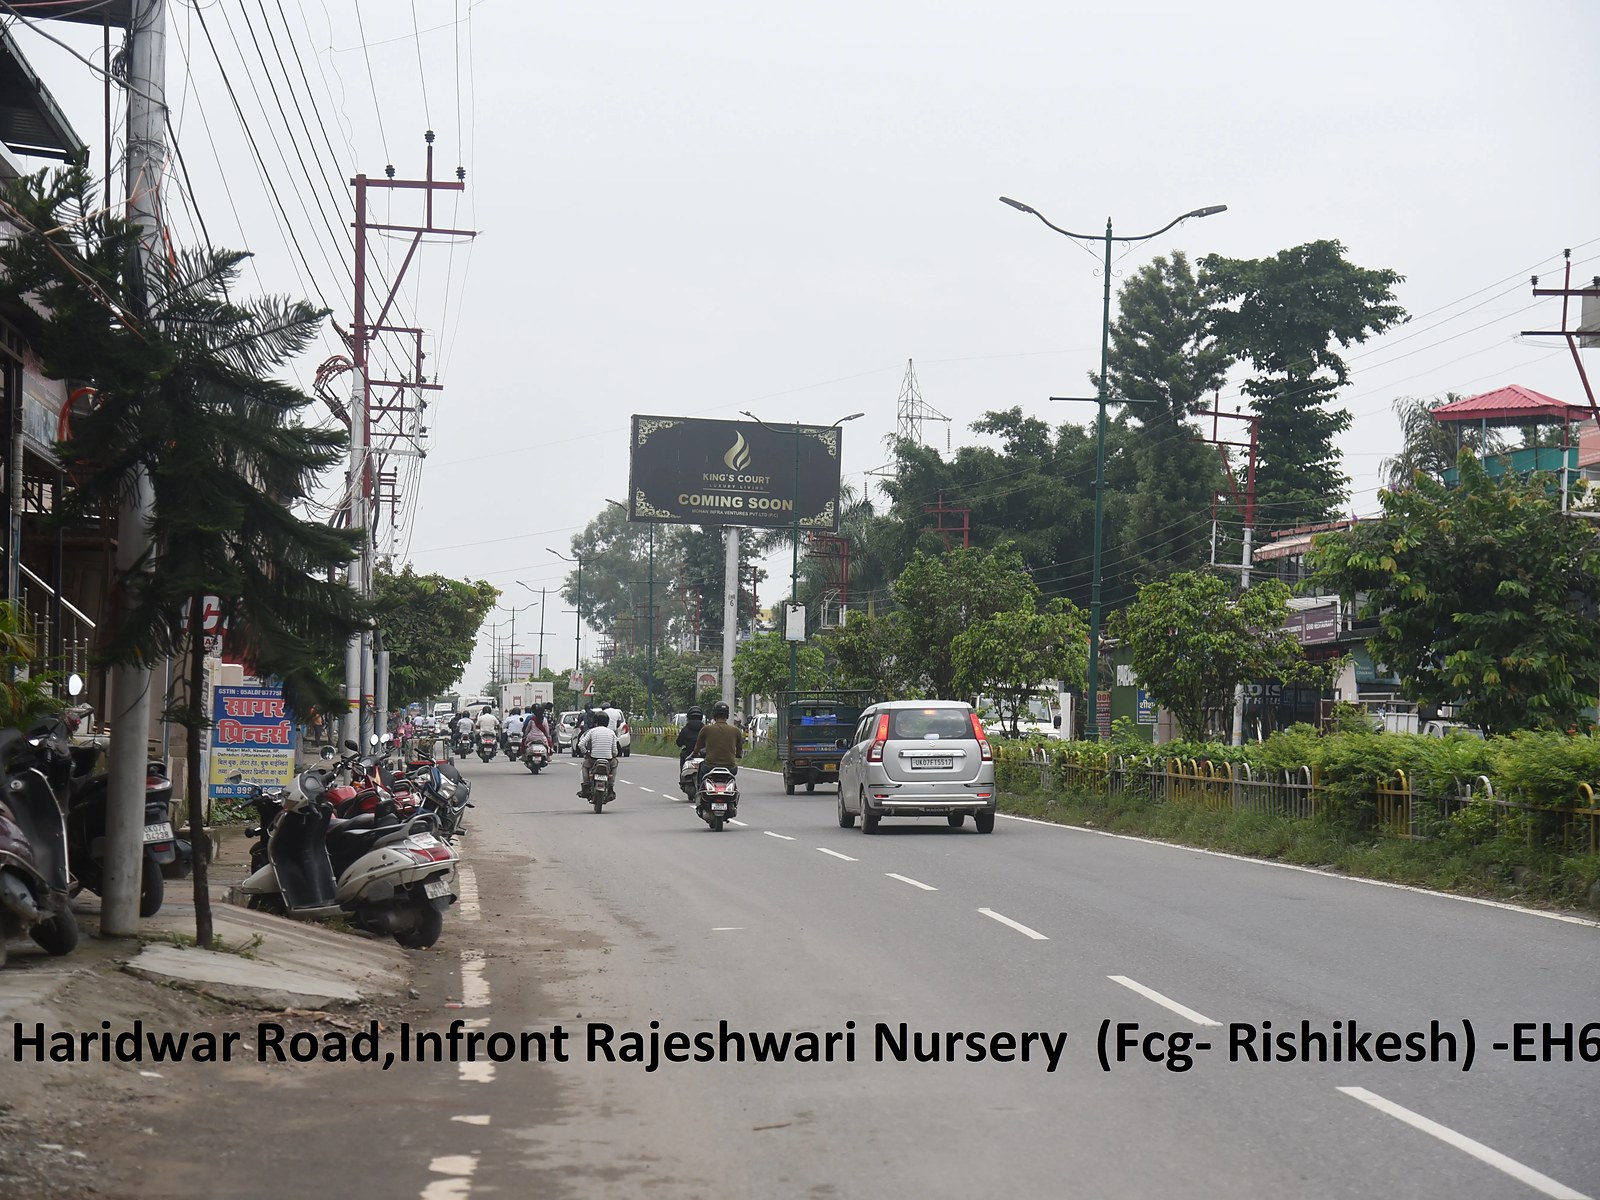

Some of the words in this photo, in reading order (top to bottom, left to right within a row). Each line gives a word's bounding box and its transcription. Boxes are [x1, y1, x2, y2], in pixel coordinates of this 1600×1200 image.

[703, 473, 734, 482] KING'S
[738, 475, 770, 484] COURT
[678, 493, 743, 508] COMING
[748, 497, 793, 511] SOON
[223, 697, 285, 718] सागर
[216, 719, 292, 744] प्रिन्टर्स
[215, 786, 235, 795] Mob.
